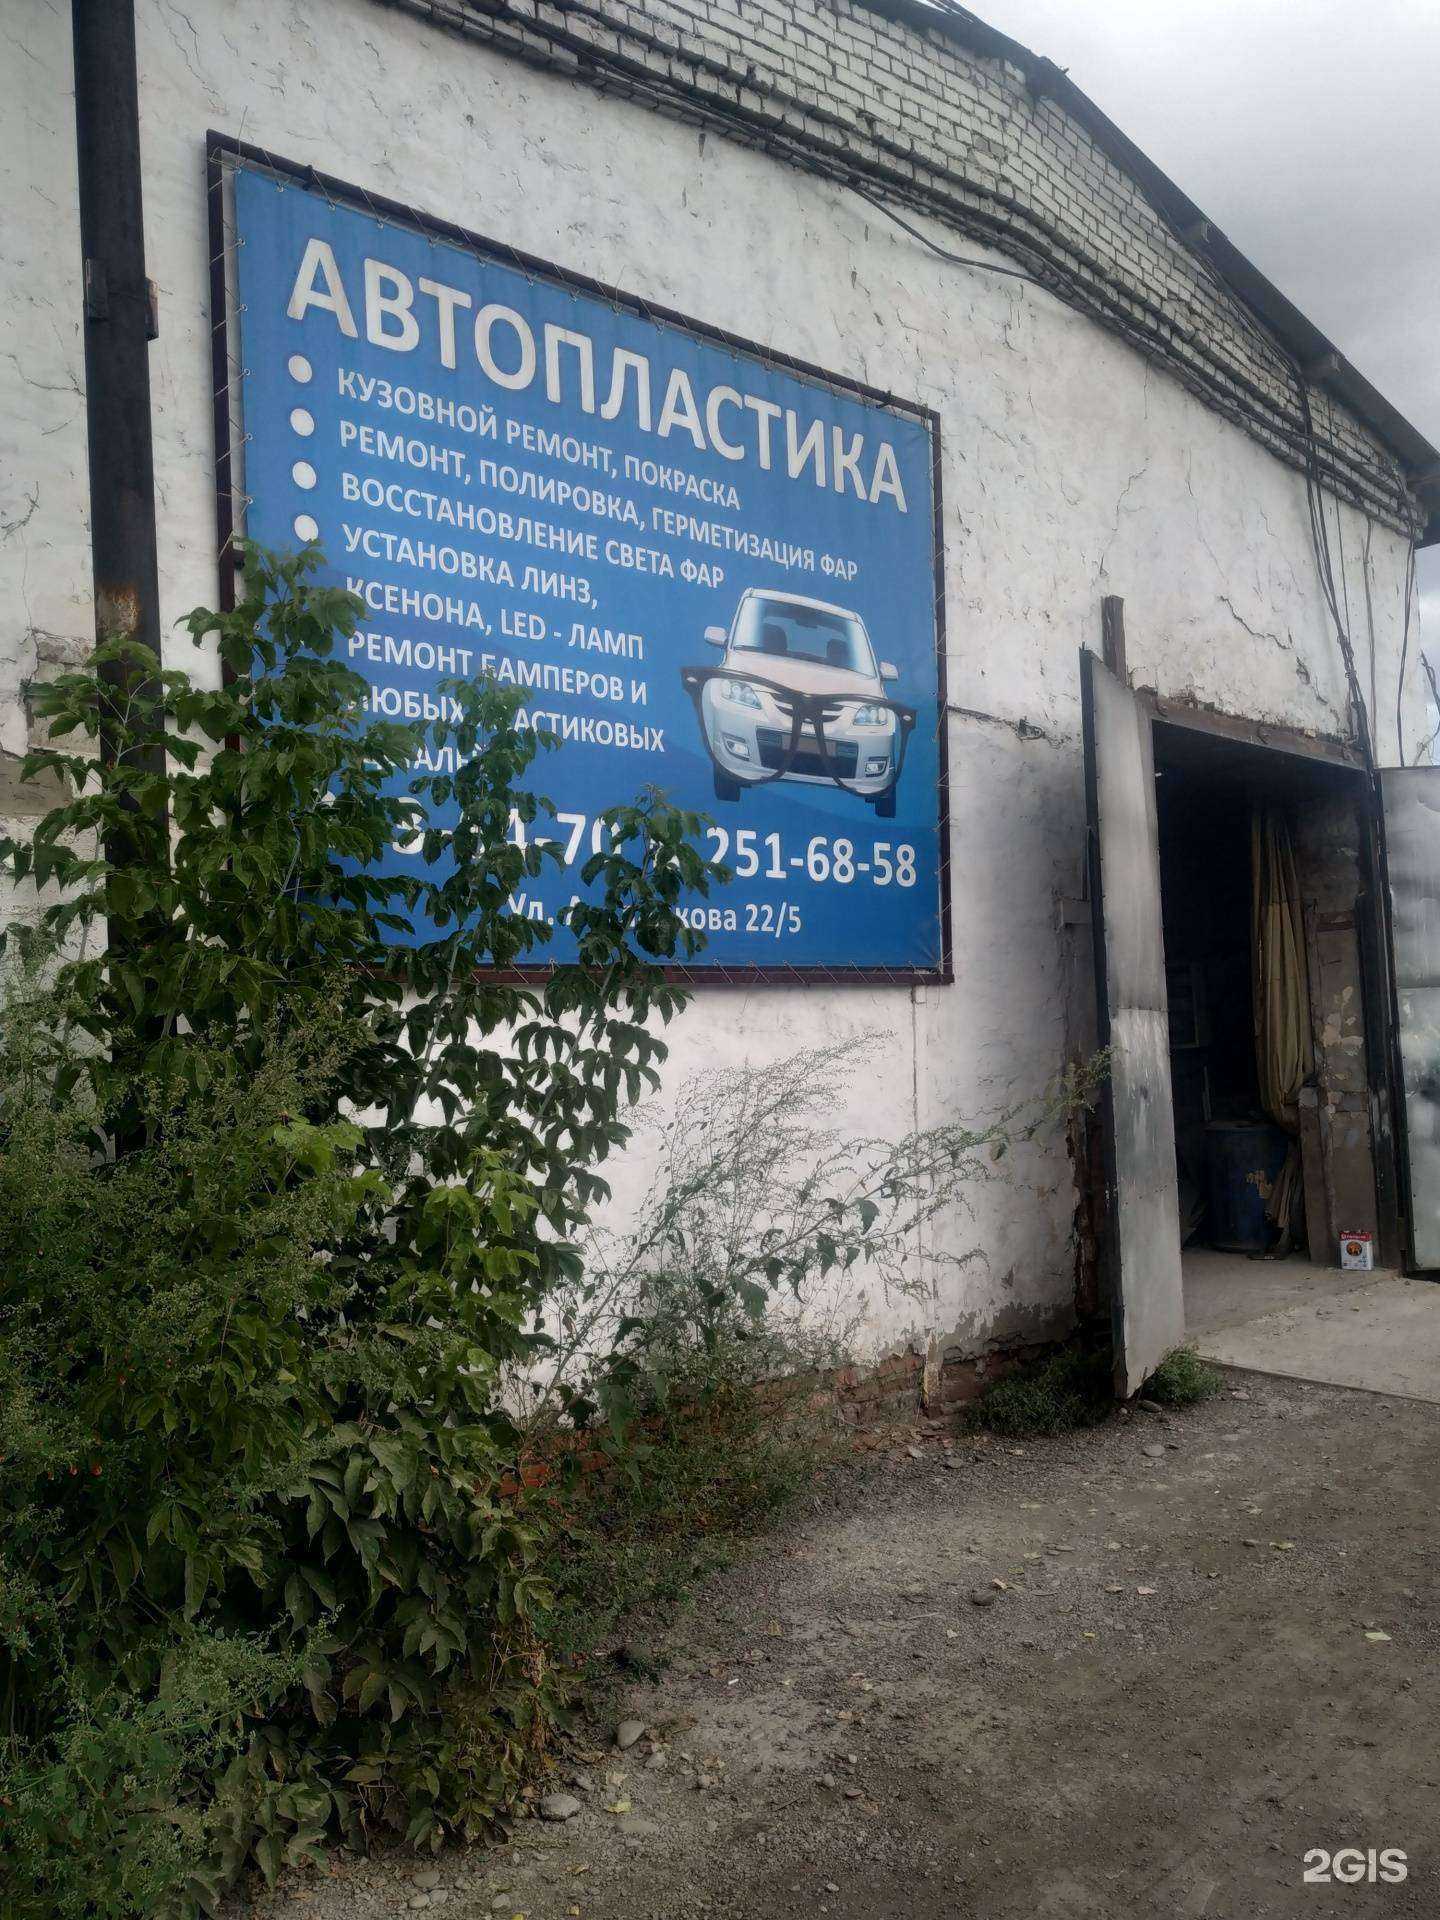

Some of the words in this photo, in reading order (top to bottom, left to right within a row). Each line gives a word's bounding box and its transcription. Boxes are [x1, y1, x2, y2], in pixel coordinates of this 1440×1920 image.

[286, 238, 909, 514] АВТОПЛАСТИКА
[338, 367, 497, 440] КУЗОВНОЙ
[505, 418, 618, 479] РЕМОНТ,
[624, 454, 741, 511] ПОКРАСКА
[340, 419, 471, 485] РЕМОНТ,
[479, 458, 645, 532] ПОЛИРОВКА,
[652, 507, 815, 571] ГЕРМЕТИЗАЦИЯ
[820, 553, 859, 582] ФАР
[341, 472, 599, 561] ВОССТАНОВЛЕНИЕ
[604, 540, 675, 578] СВЕТА
[680, 558, 725, 589] ФАР
[341, 523, 515, 588] УСТАНОВКА
[521, 566, 598, 610] ЛИНЗ,
[348, 630, 473, 677] РЕМОНТ
[631, 679, 648, 706] И
[501, 608, 546, 641] LED
[568, 623, 644, 660] ЛАМП
[348, 684, 464, 723] ЮБЫХ
[474, 704, 665, 753] АСТИКОВЫХ
[706, 826, 917, 888] 251-68-58
[745, 902, 802, 938] 22/5
